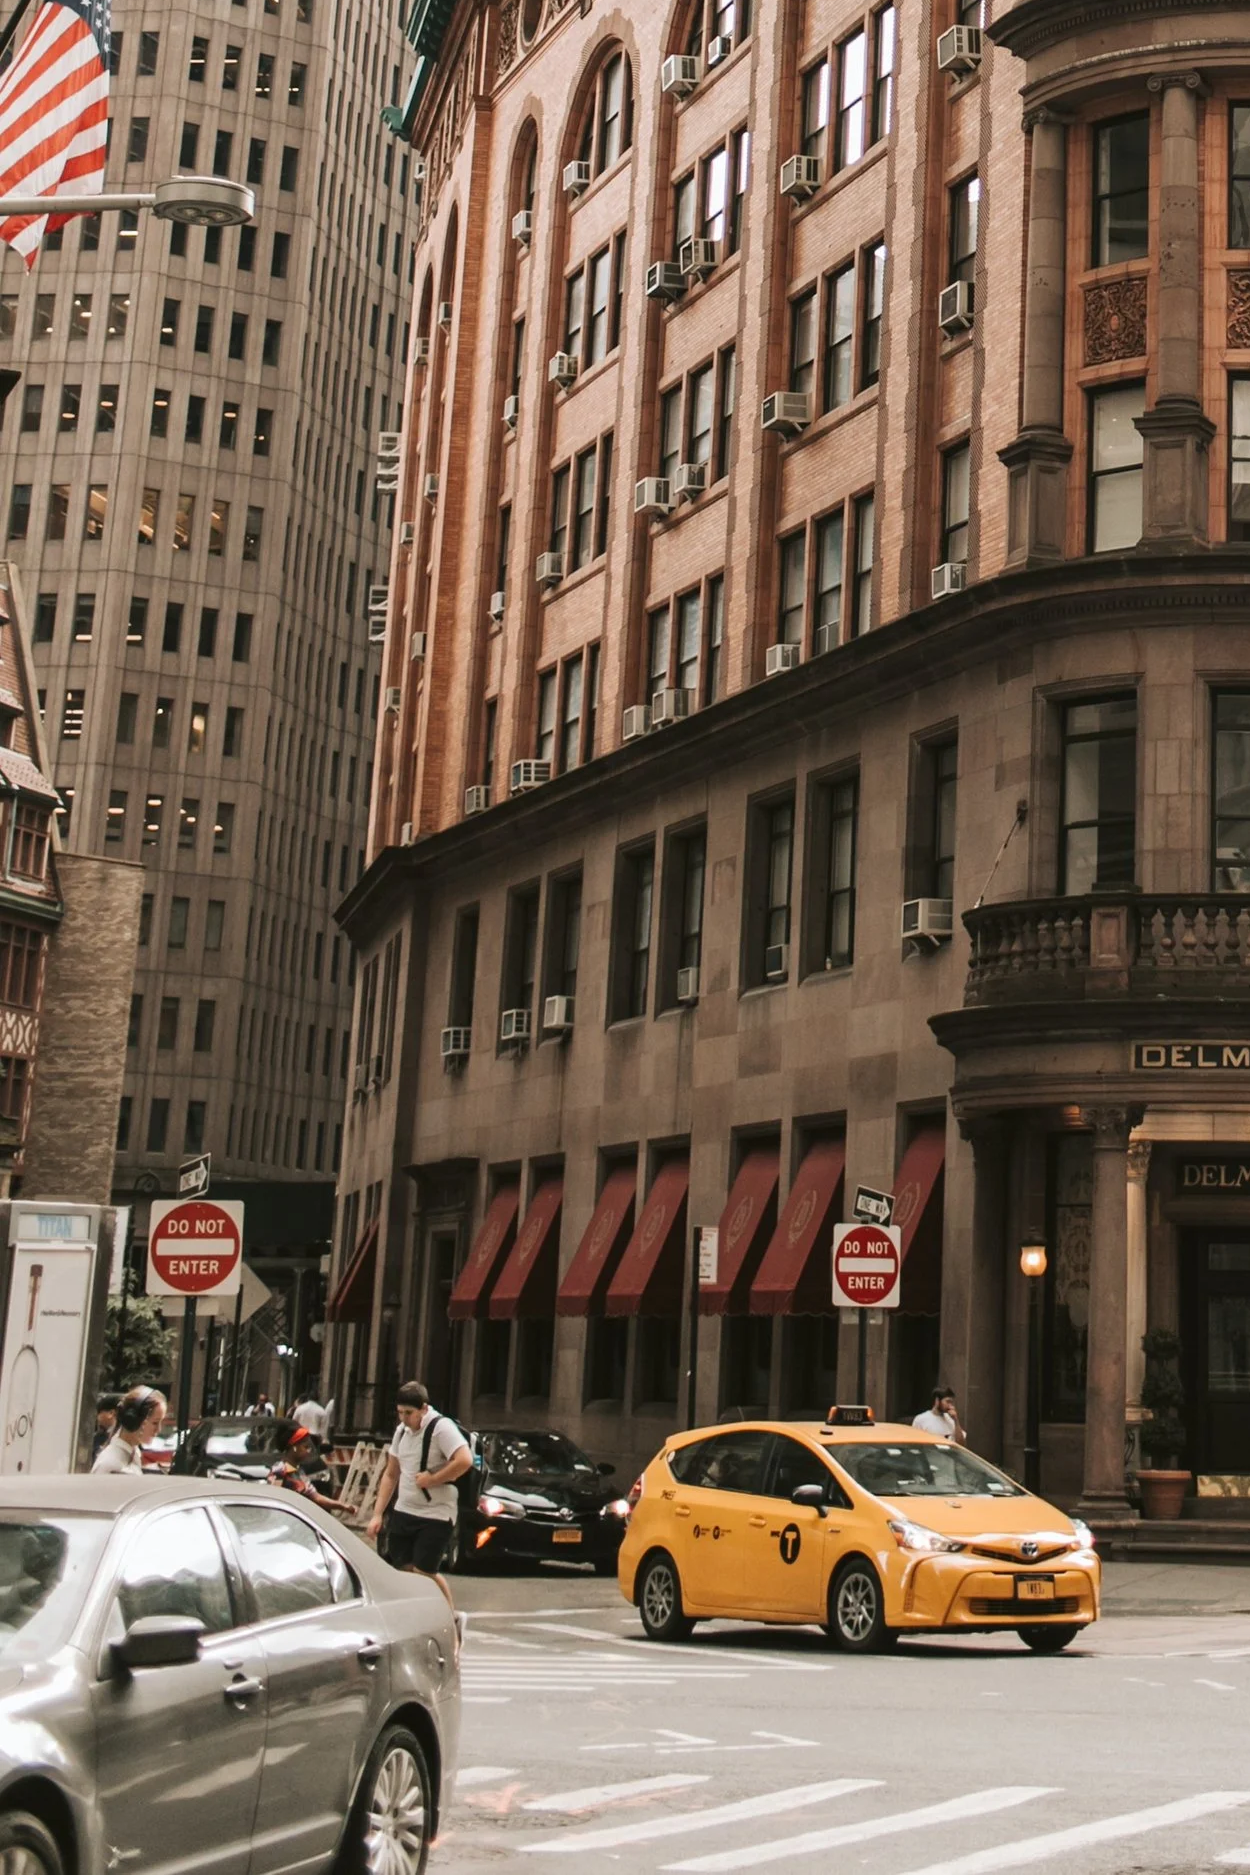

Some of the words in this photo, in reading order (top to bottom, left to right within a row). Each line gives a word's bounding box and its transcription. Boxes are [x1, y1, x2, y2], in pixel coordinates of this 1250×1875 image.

[168, 1219, 189, 1234] DO
[195, 1219, 226, 1234] NOT
[844, 1241, 860, 1254] DO
[867, 1242, 889, 1254] NOT
[169, 1260, 219, 1275] ENTER
[848, 1276, 885, 1289] ENTER
[785, 1531, 797, 1559] T
